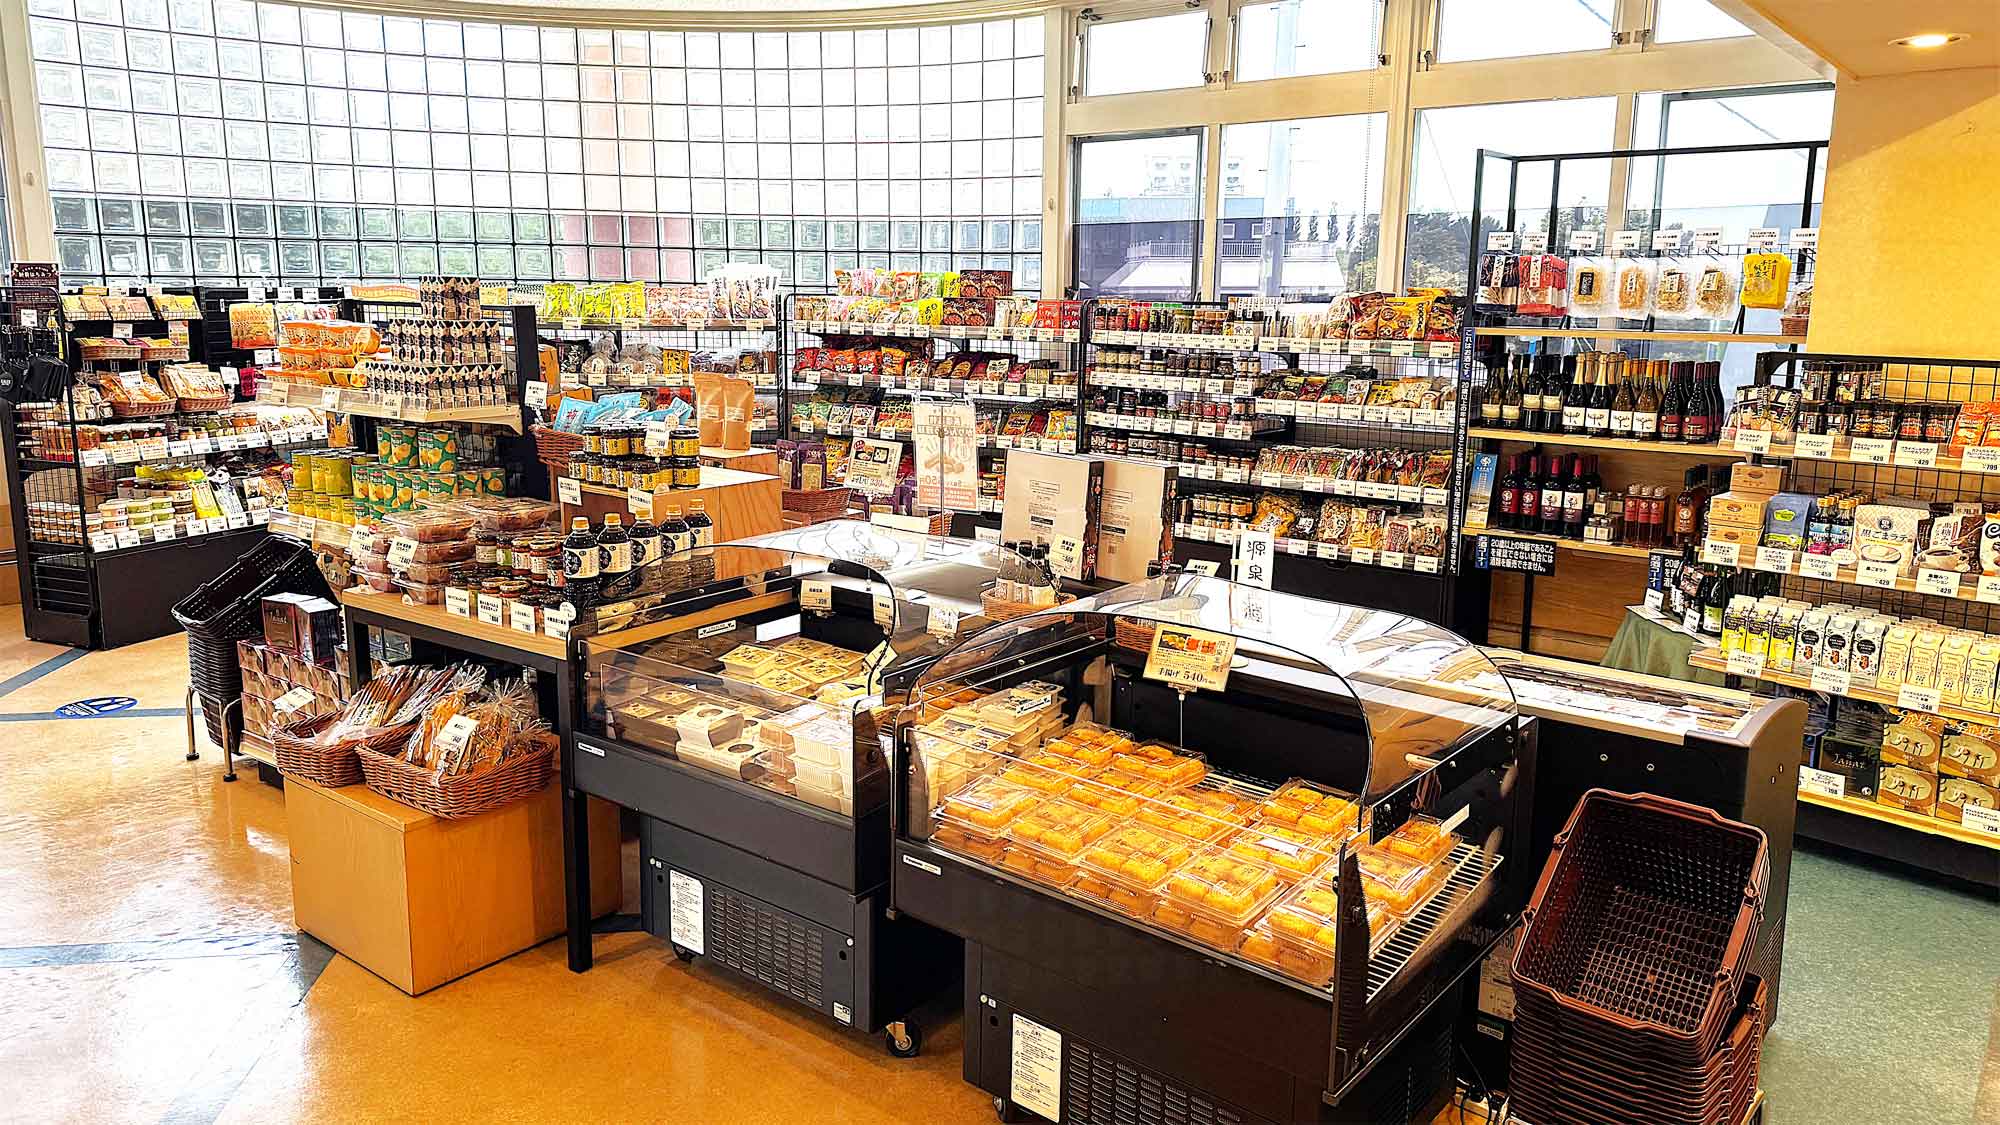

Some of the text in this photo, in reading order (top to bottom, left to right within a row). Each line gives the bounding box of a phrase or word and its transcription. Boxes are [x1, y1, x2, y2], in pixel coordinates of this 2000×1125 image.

[1861, 529, 1908, 543] 黒ごまラテ
[1491, 538, 1555, 555] 20歳以上の年齢であること
[1246, 540, 1266, 582] 源泉
[1489, 556, 1547, 573] 酒類を販売できません。
[1490, 548, 1554, 564] を確認できない場合には
